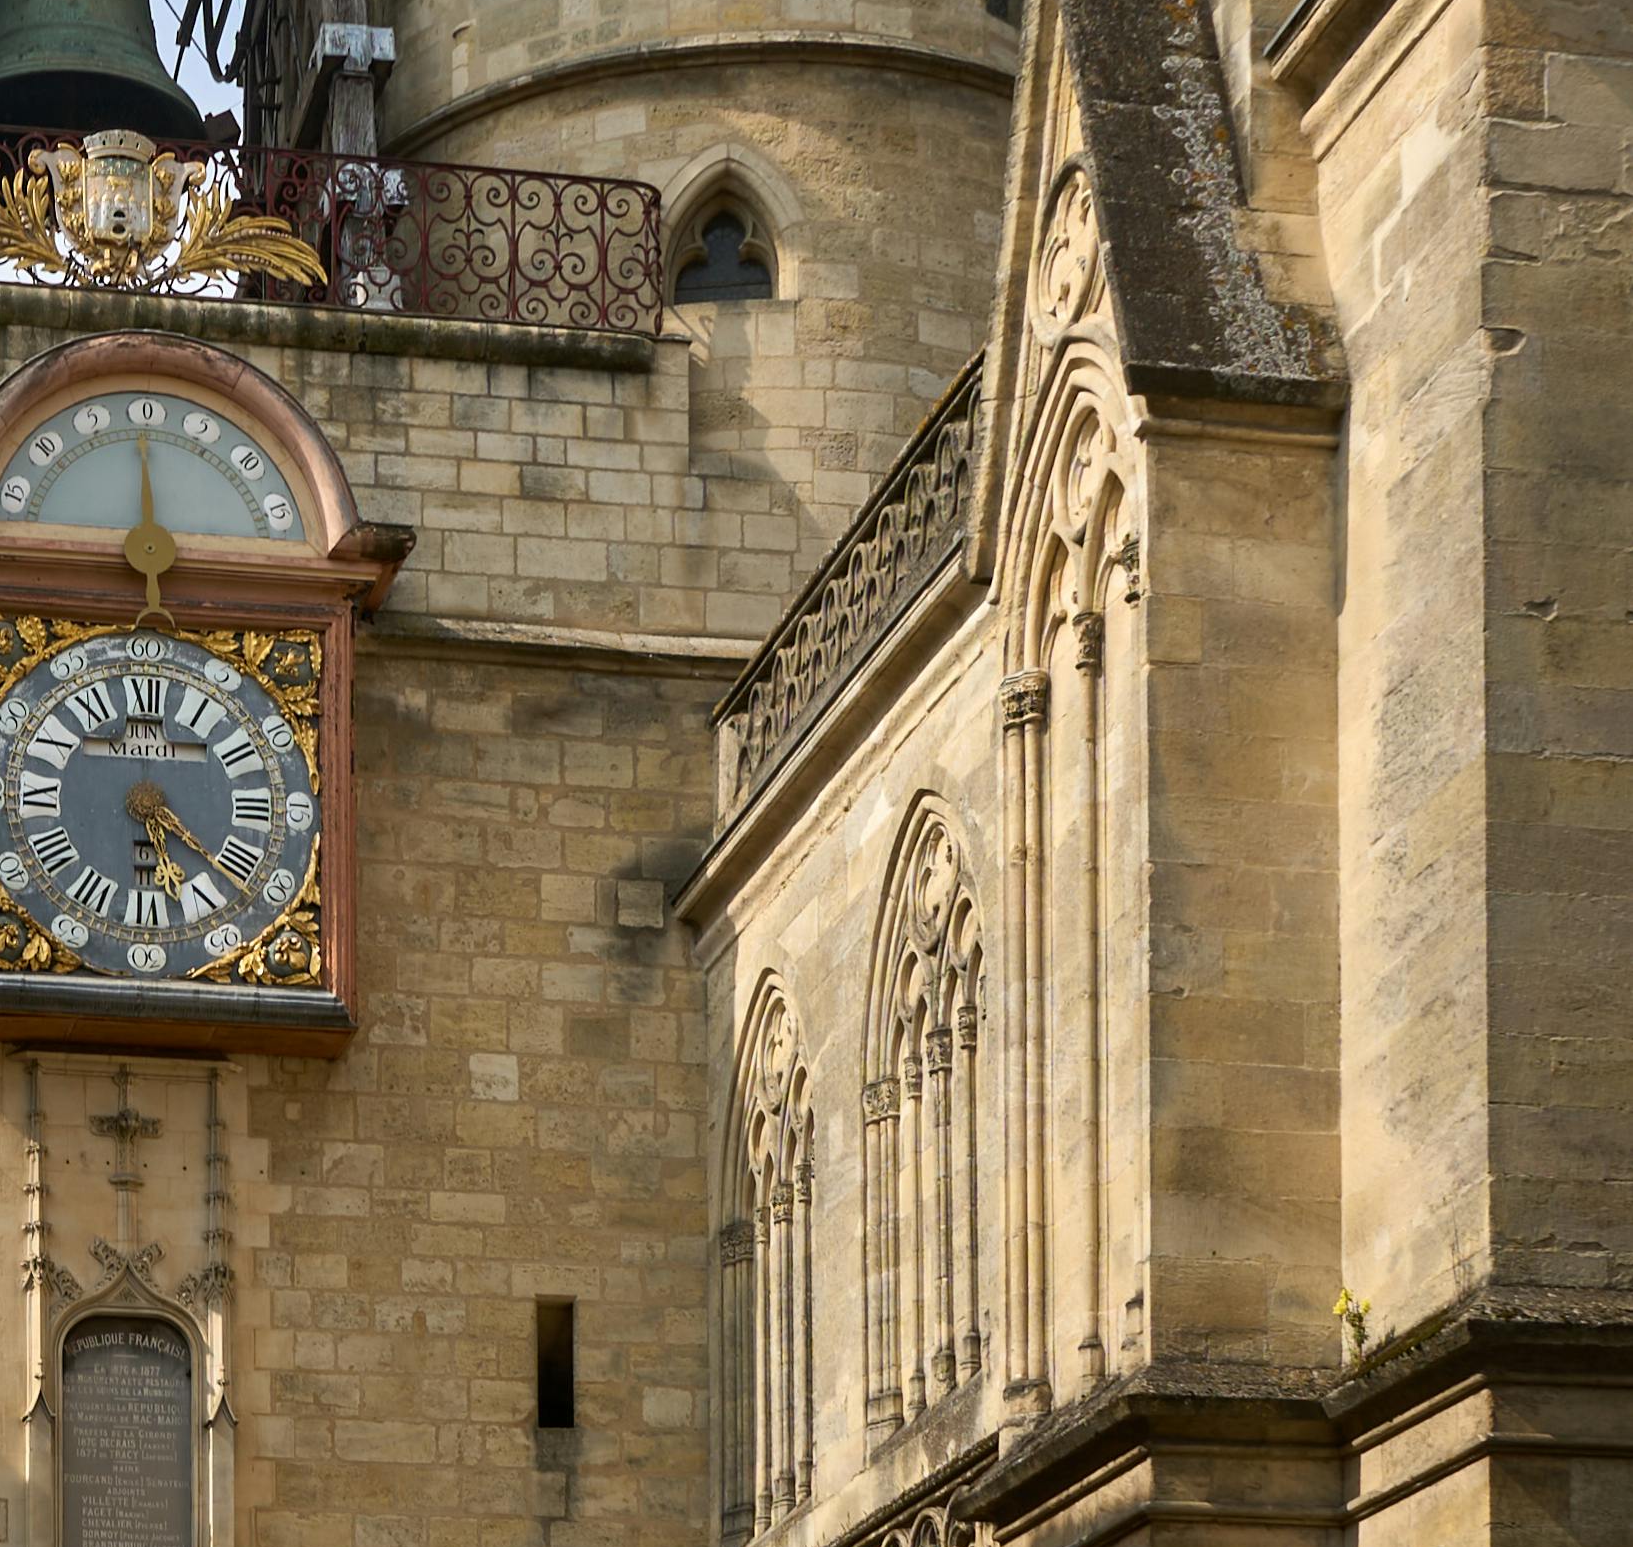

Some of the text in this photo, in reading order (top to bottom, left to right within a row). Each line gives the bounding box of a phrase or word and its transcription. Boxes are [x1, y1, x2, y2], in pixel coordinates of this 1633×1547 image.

[86, 407, 99, 429] 5
[142, 402, 154, 420] 0
[195, 418, 209, 435] 5
[35, 437, 56, 458] 10
[238, 451, 260, 472] 10
[4, 482, 26, 503] 15
[269, 502, 290, 520] 15
[131, 636, 161, 659] 60
[55, 650, 84, 676] 55
[214, 665, 231, 683] 5
[130, 678, 161, 714] XII
[0, 700, 27, 731] 50
[75, 687, 110, 729] XI
[126, 724, 157, 741] JUIN
[267, 723, 292, 748] 10
[35, 727, 74, 761] X
[221, 742, 256, 767] II
[23, 782, 59, 808] IX
[235, 797, 269, 822] III
[289, 803, 310, 823] 15
[33, 829, 76, 873] VIII
[139, 846, 150, 861] 6
[0, 856, 26, 884] 40
[74, 869, 112, 913] VII
[266, 872, 293, 903] 20
[136, 891, 159, 926] VI
[191, 883, 218, 919] V
[58, 918, 86, 947] 35
[210, 927, 238, 953] 25
[132, 947, 161, 969] 30
[141, 1366, 161, 1377] 1877
[76, 1448, 97, 1458] 1877
[82, 1496, 128, 1506] VILLETTE
[107, 1487, 146, 1497] ADJOINTS
[81, 1518, 134, 1530] CHEVALIER
[82, 1529, 118, 1539] DORMOY
